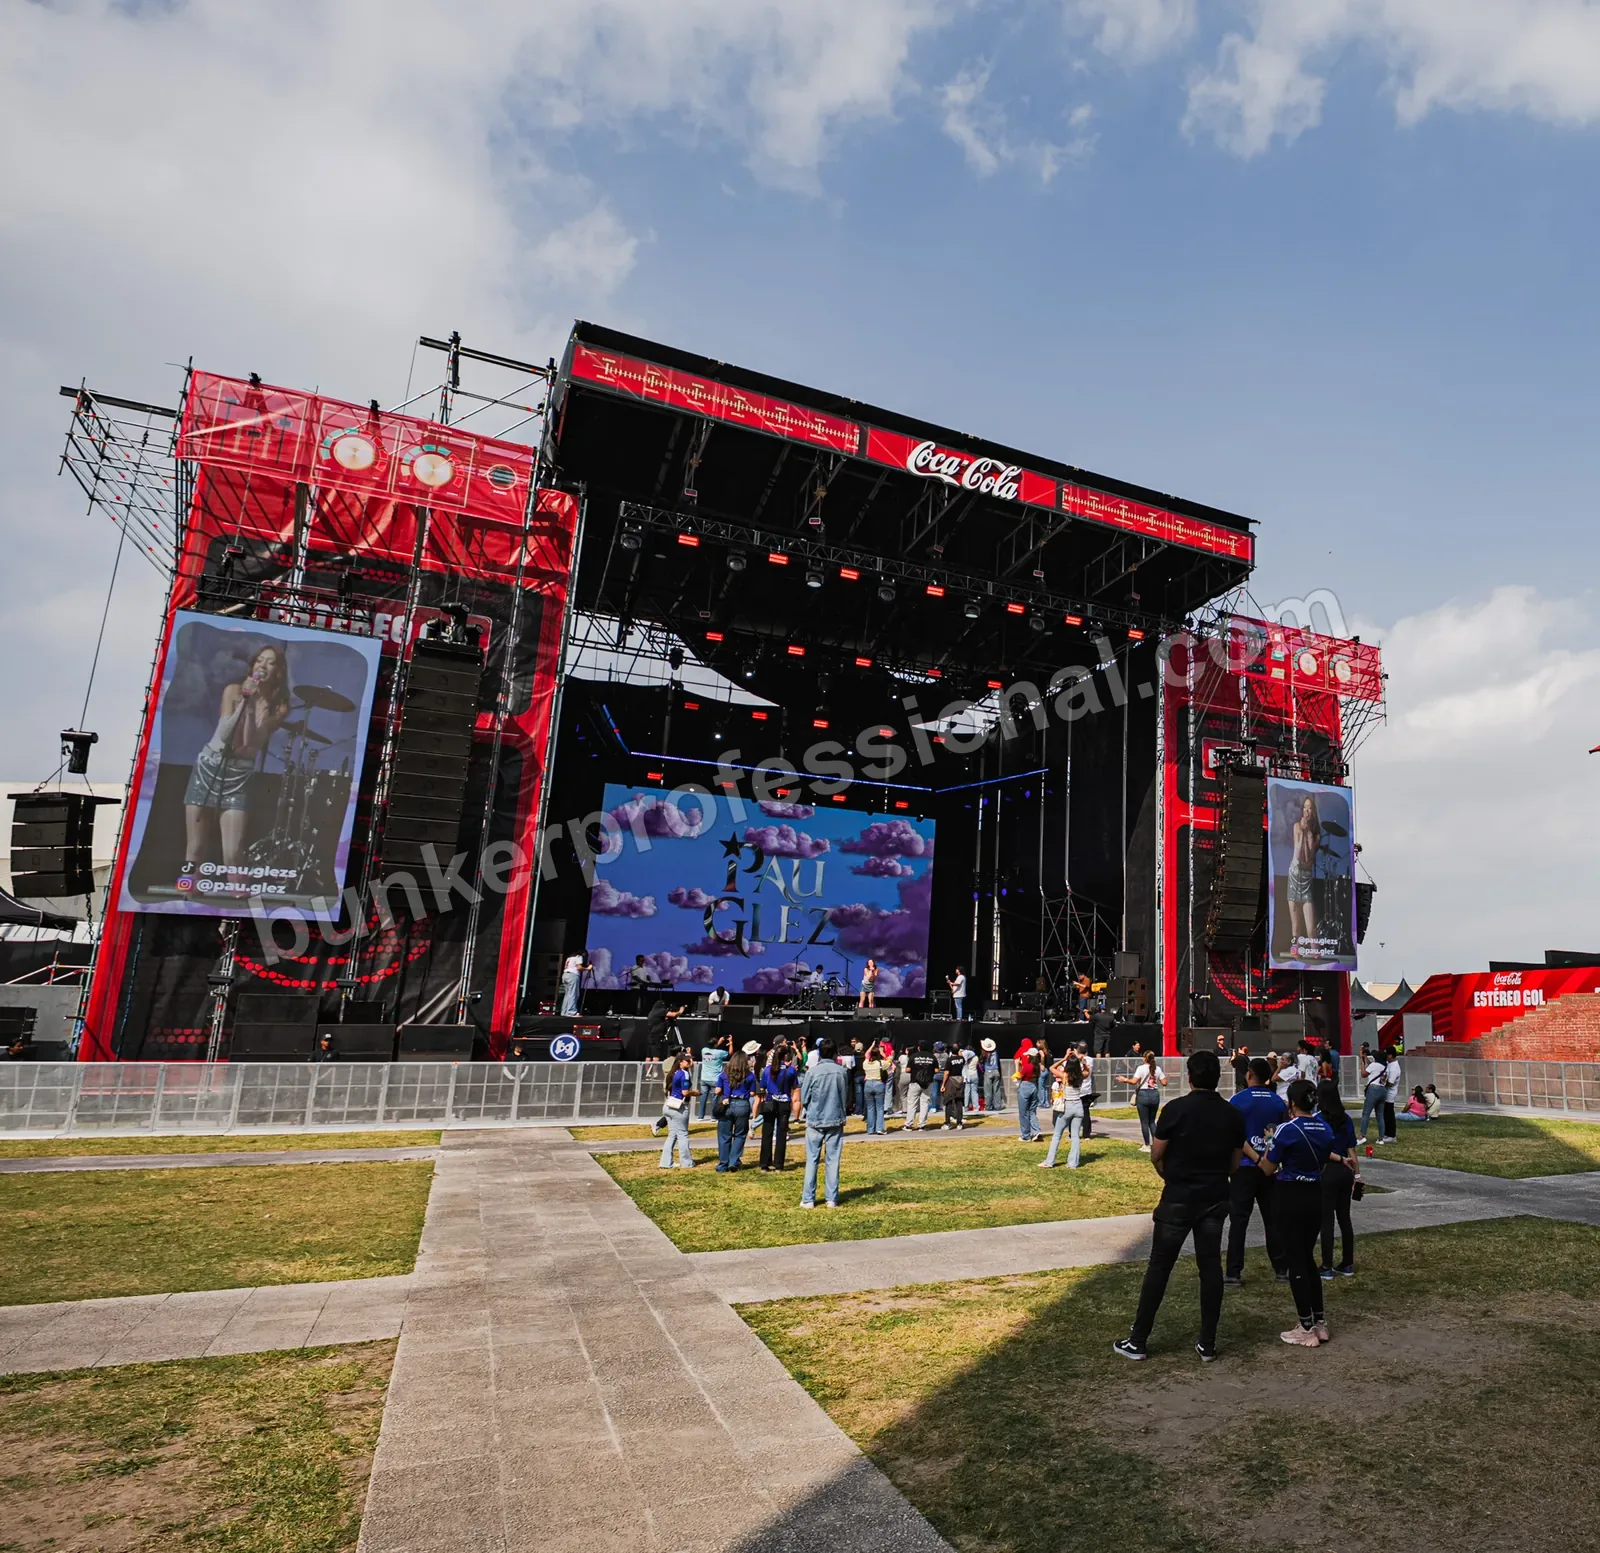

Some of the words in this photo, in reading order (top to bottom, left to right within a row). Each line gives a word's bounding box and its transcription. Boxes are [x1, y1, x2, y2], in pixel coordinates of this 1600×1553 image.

[196, 879, 287, 895] @pau.glez
[718, 831, 826, 905] PAU
[703, 896, 837, 959] GLEZ
[1473, 986, 1522, 1007] ESTÉREO
[1523, 988, 1546, 1006] GOL
